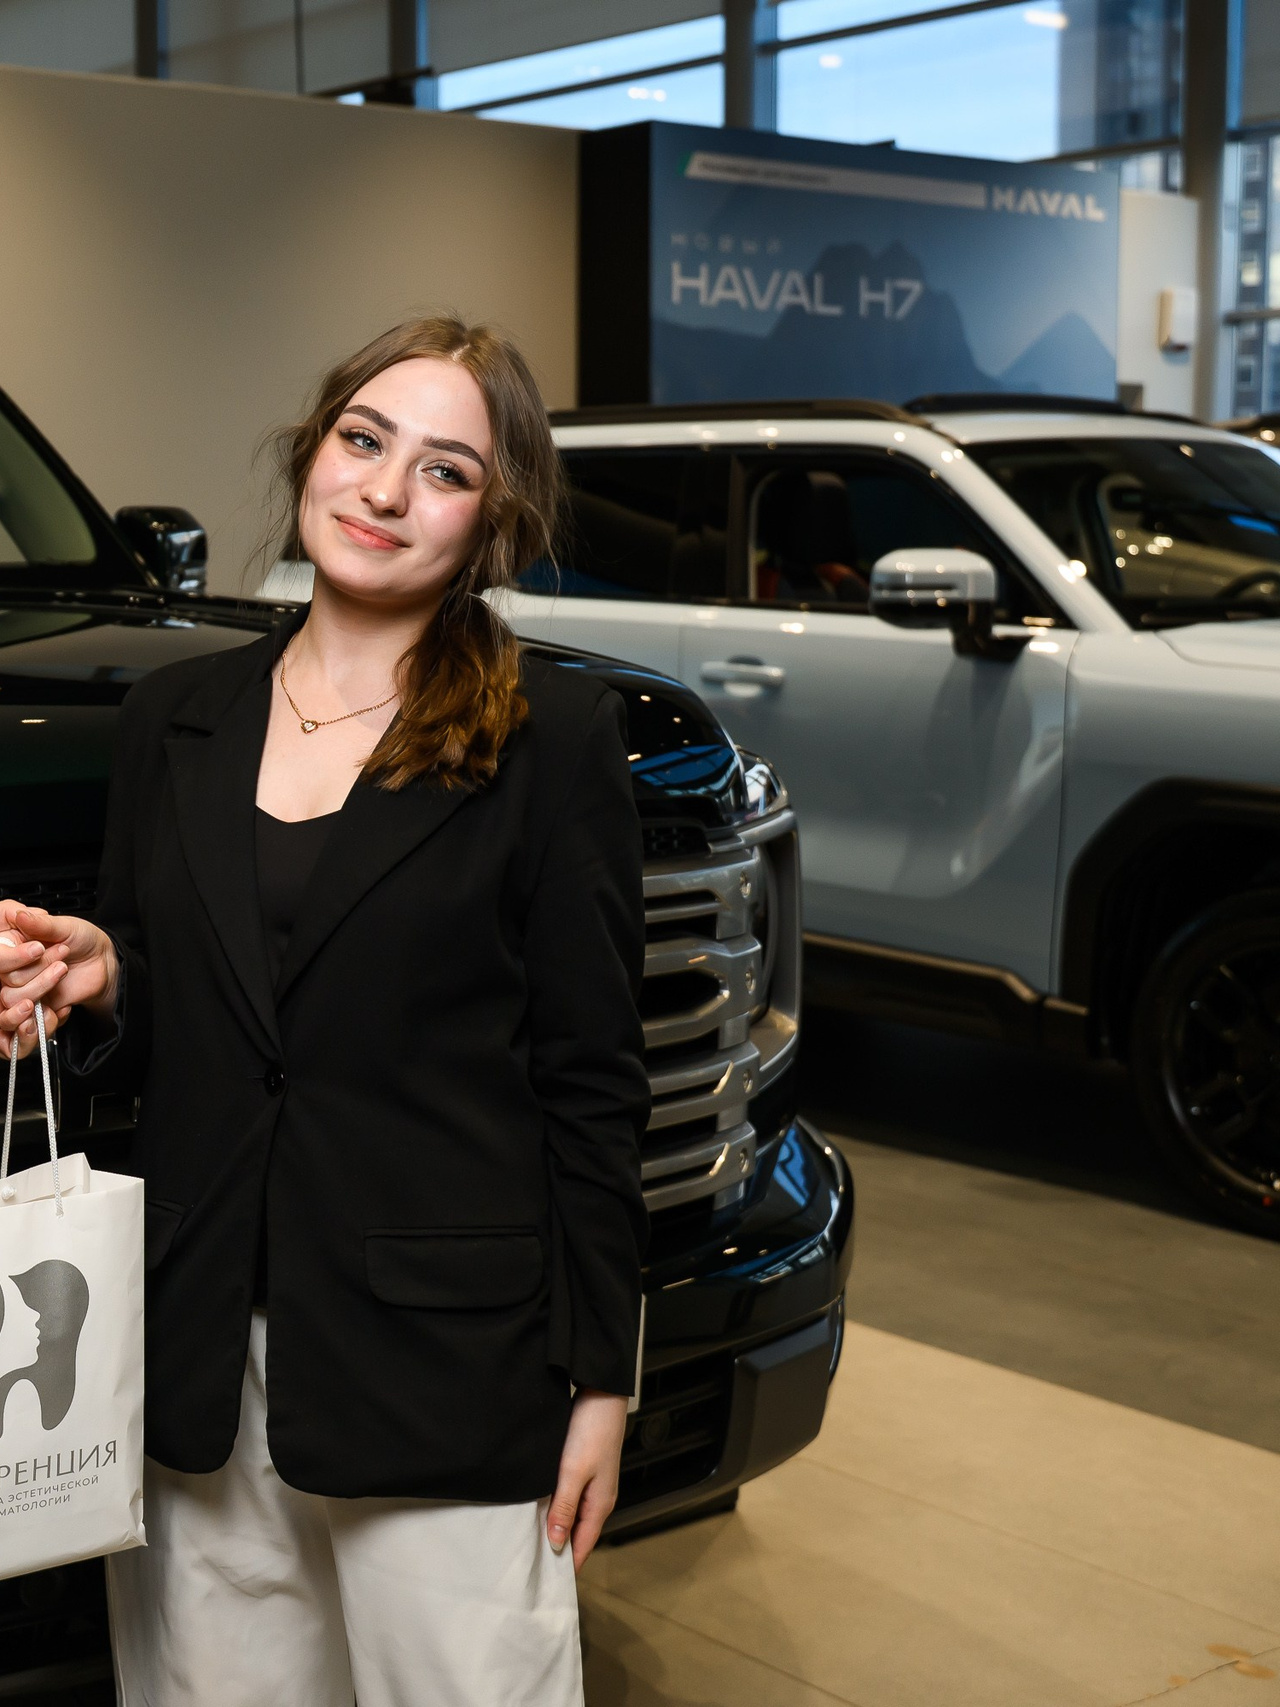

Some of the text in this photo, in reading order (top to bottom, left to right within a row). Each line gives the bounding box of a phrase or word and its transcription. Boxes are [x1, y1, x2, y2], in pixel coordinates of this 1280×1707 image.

[992, 185, 1106, 222] HAVAL
[670, 261, 923, 320] HAVAL H7
[7, 1474, 99, 1503] ЭСТЕТИЧЕСКОЙ
